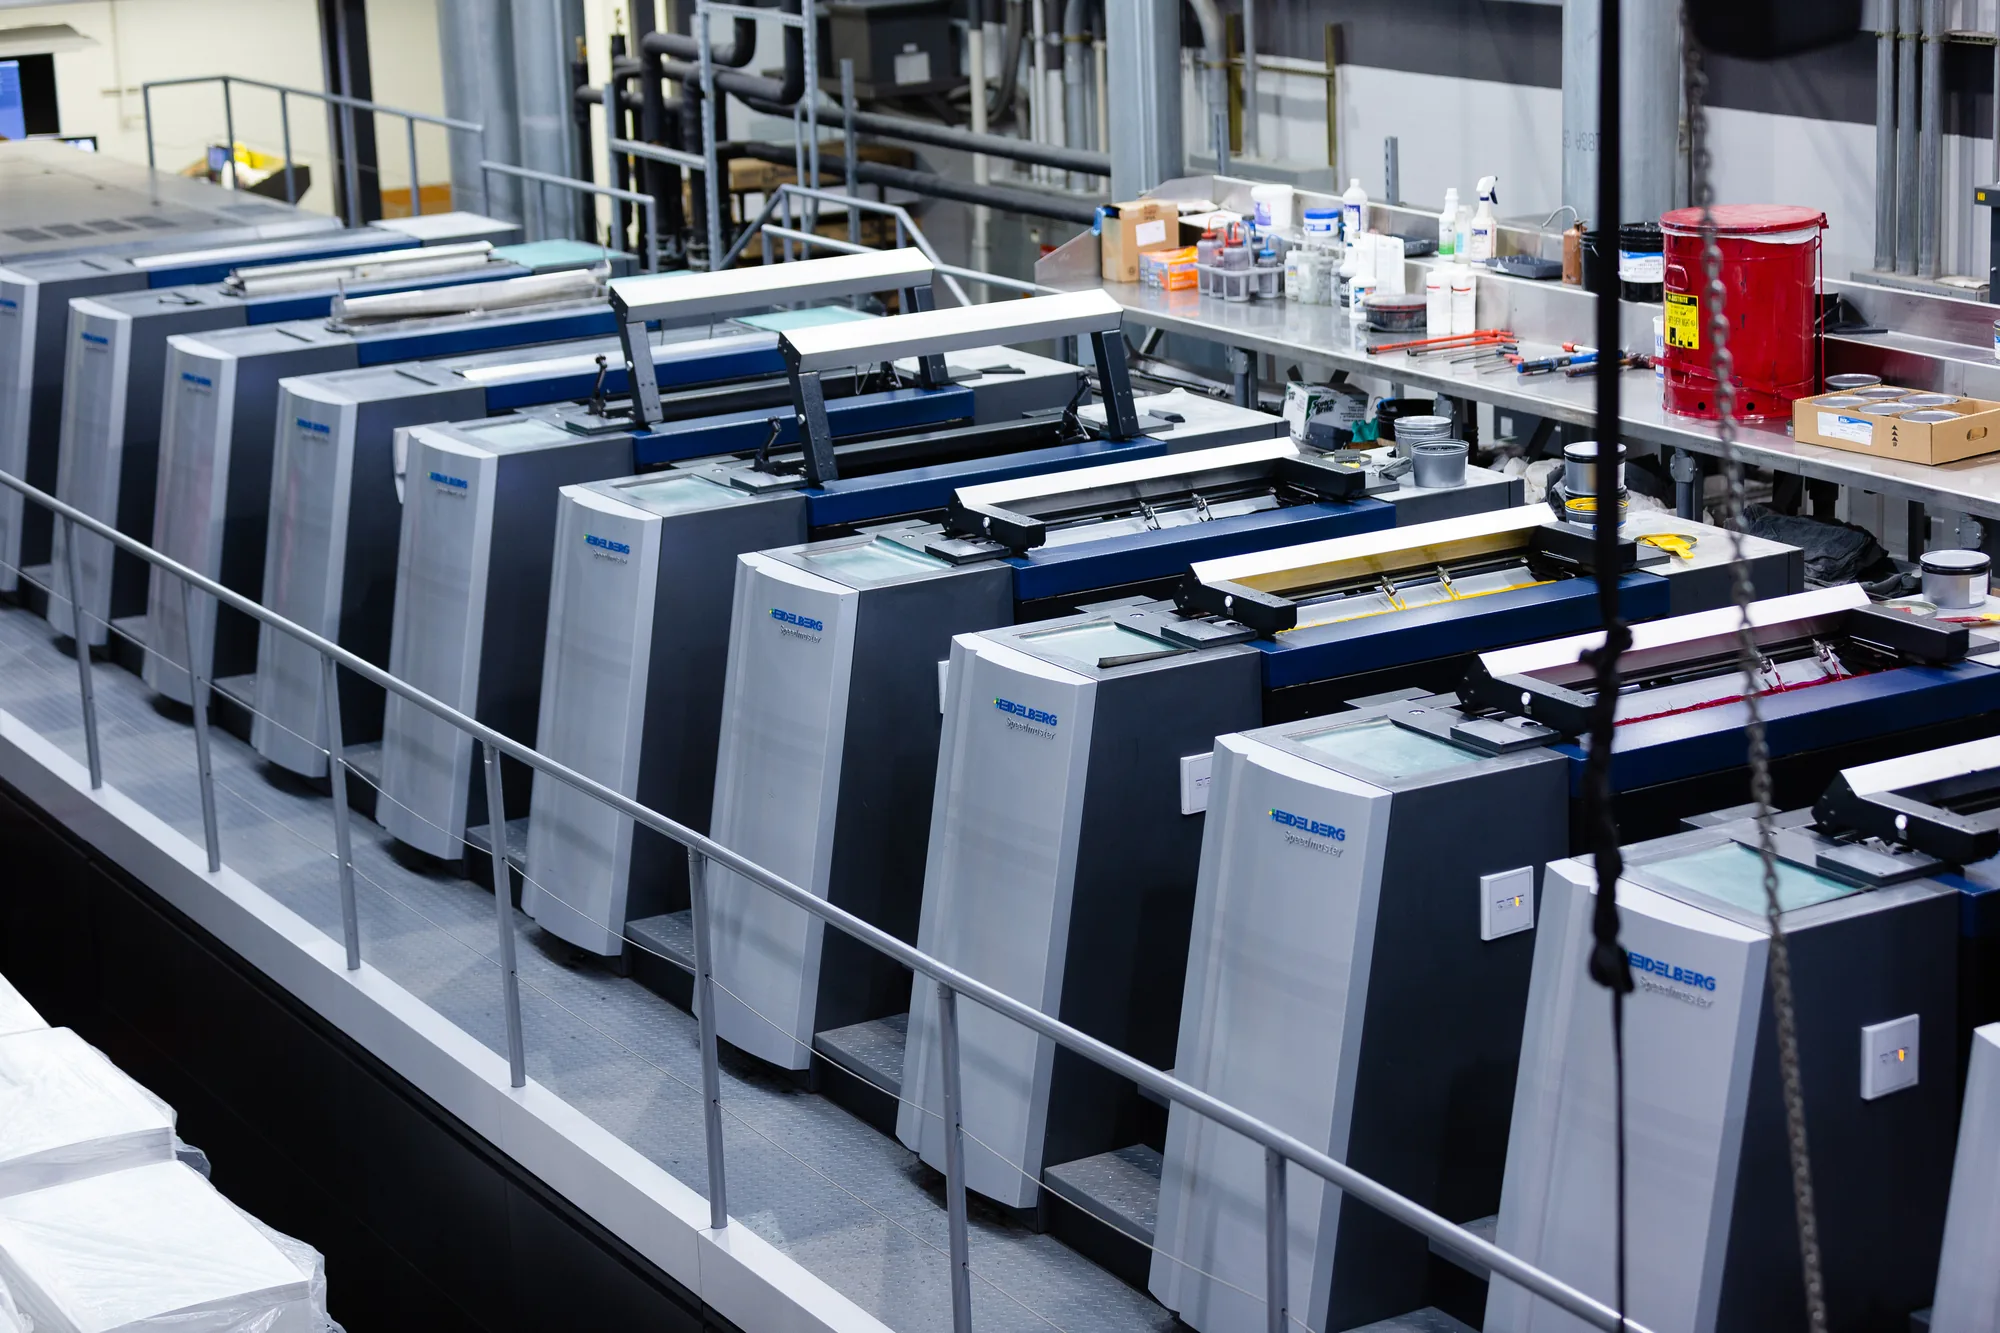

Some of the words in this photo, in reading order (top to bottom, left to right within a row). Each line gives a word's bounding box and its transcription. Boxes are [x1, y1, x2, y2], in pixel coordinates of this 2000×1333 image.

[769, 607, 823, 632] HEIDELBERG
[993, 696, 1058, 726] HEIDELBERG
[1006, 717, 1057, 740] Speedmaster
[1268, 807, 1346, 842] HEIDELBERG
[1284, 830, 1344, 858] Speedmaster
